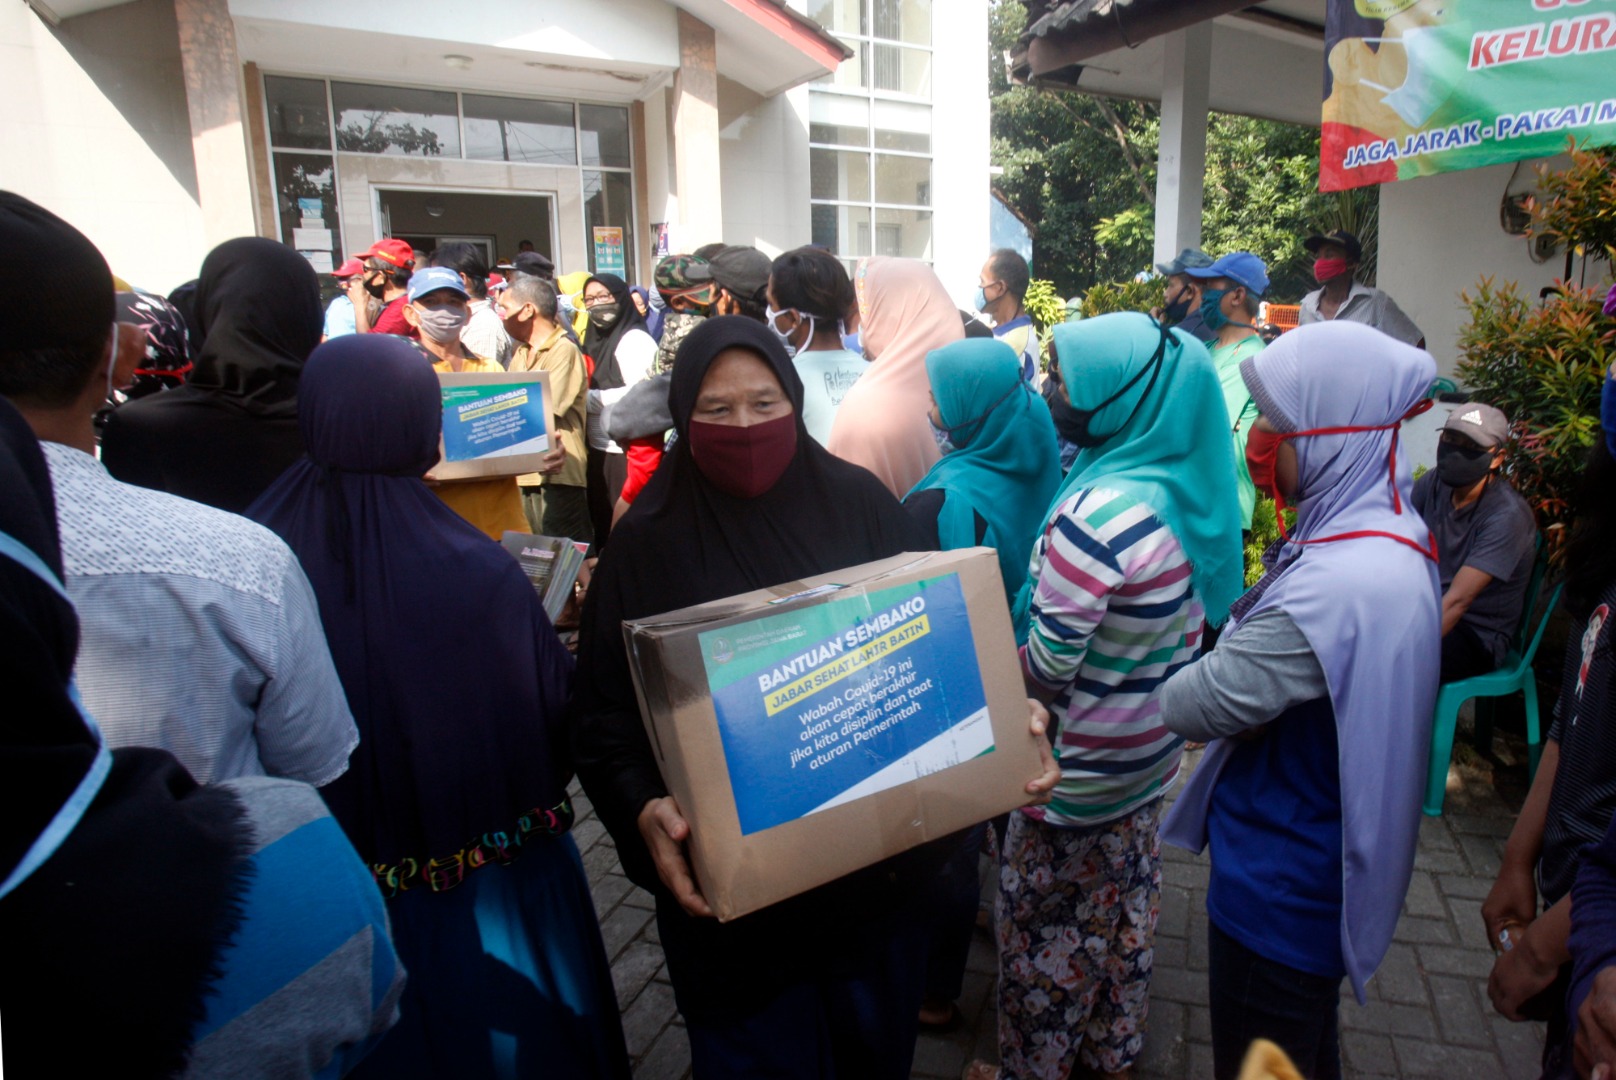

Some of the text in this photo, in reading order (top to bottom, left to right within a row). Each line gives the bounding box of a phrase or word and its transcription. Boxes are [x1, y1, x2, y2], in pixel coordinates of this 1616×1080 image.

[1344, 139, 1398, 167] JAGA
[1402, 122, 1479, 156] JARAK
[1497, 104, 1592, 138] PAKAI
[758, 596, 926, 693] BANTUAN SEMBAKO
[772, 621, 925, 709] JABAR SEHAT LAHIR BATIN
[790, 677, 933, 769] jika kita disiplin dan taat
[798, 656, 913, 726] Wabah Covid-19 ini
[800, 670, 917, 741] akan cepat berakhir
[809, 741, 853, 770] aturan
[853, 700, 922, 746] Pemerintah
